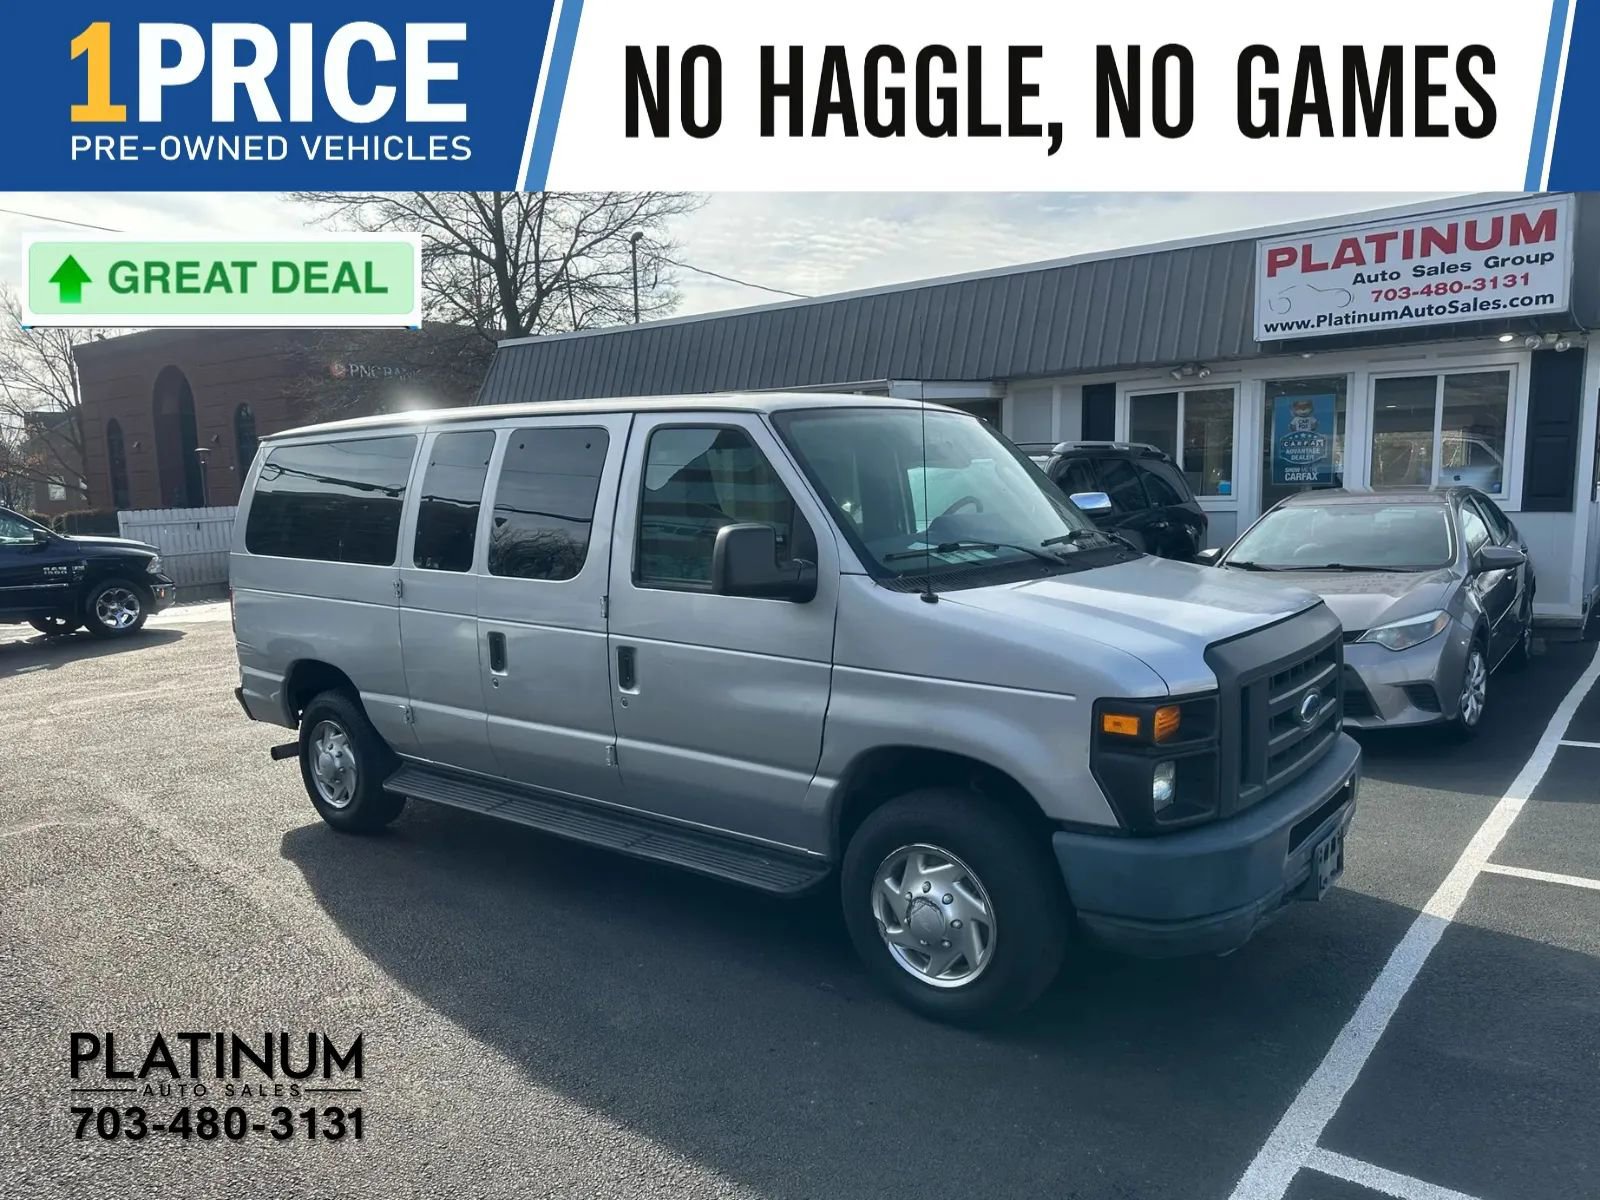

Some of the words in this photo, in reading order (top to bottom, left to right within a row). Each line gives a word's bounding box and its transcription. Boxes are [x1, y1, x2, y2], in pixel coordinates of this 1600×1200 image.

[1267, 208, 1557, 278] PLATINUM
[1352, 271, 1401, 286] Auto
[1411, 260, 1472, 279] Sales
[1483, 249, 1555, 270] Group
[1371, 272, 1530, 303] 703-480-3131
[1264, 291, 1554, 333] www.PlatinumAutoSales.com
[1285, 472, 1318, 481] CARFAX
